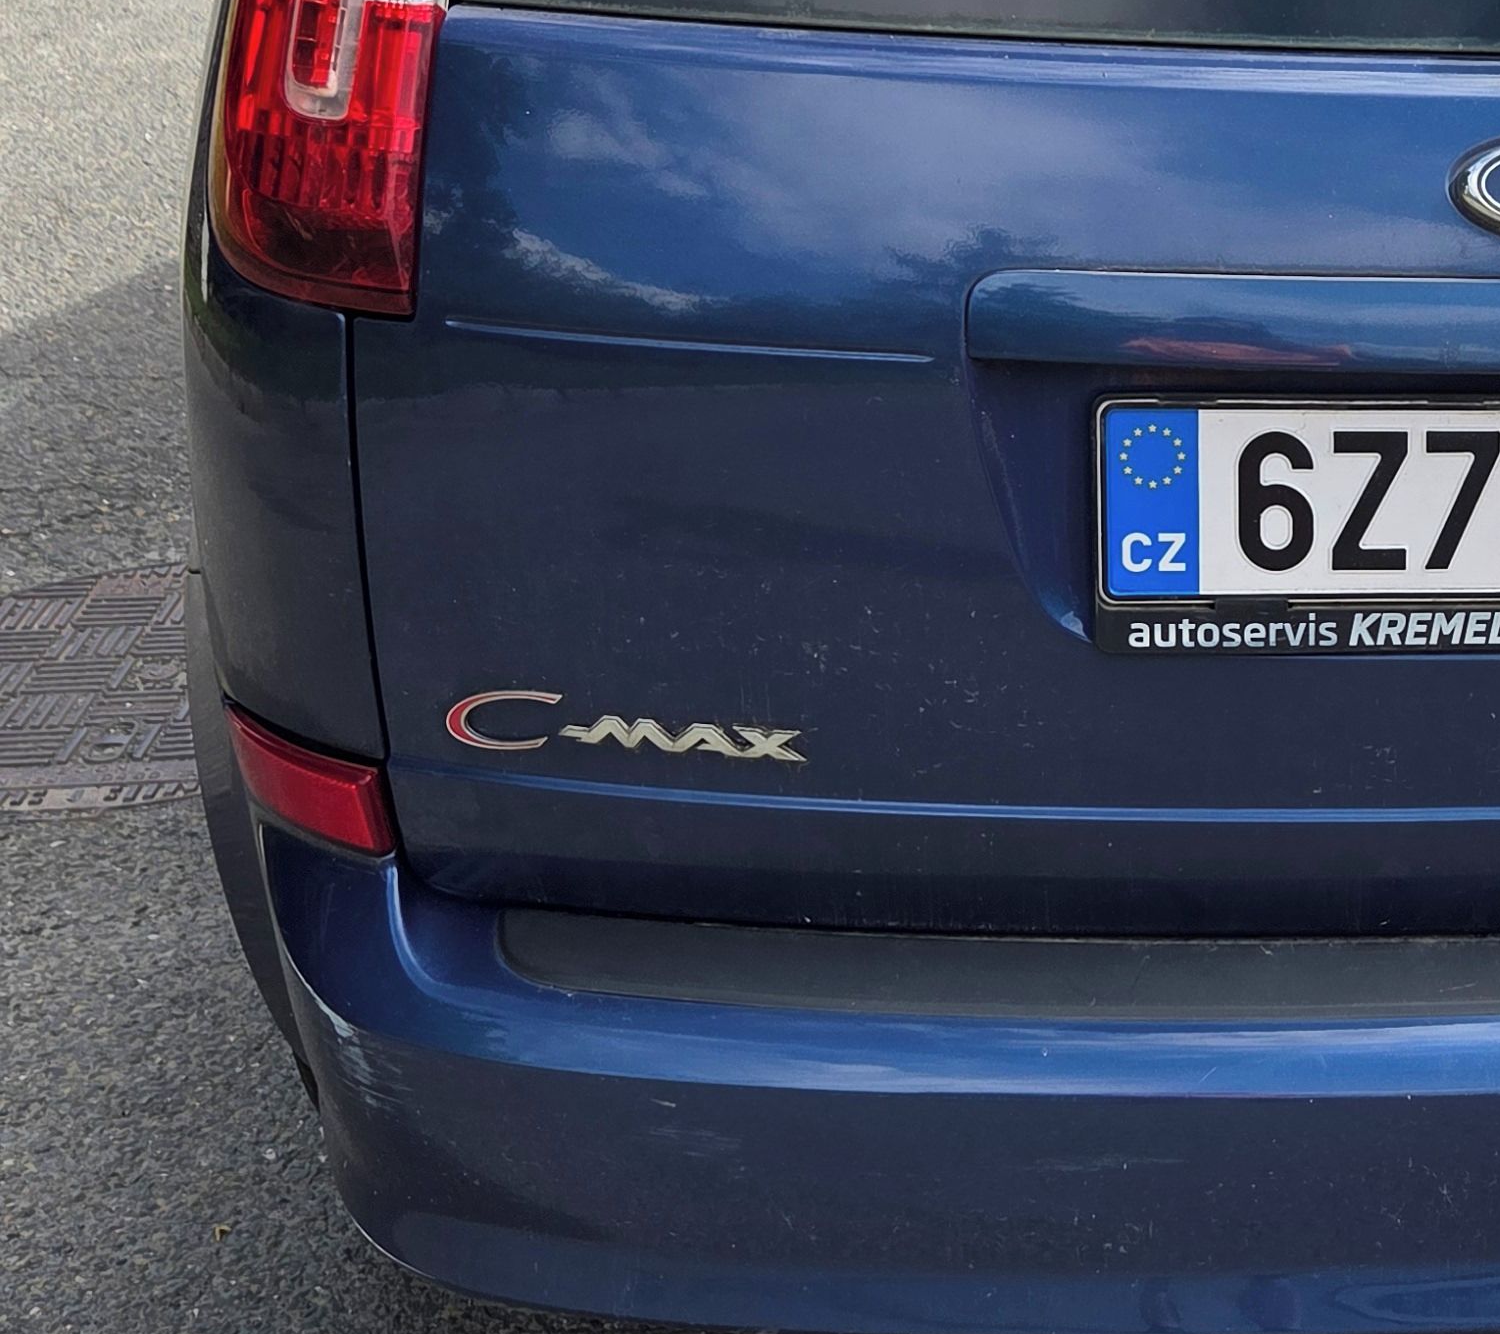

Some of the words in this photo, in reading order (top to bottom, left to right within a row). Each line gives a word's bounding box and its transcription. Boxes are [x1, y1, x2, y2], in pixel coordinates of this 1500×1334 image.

[1235, 430, 1500, 573] 6Z7
[1121, 532, 1187, 573] CZ
[1128, 612, 1338, 648] autoservis
